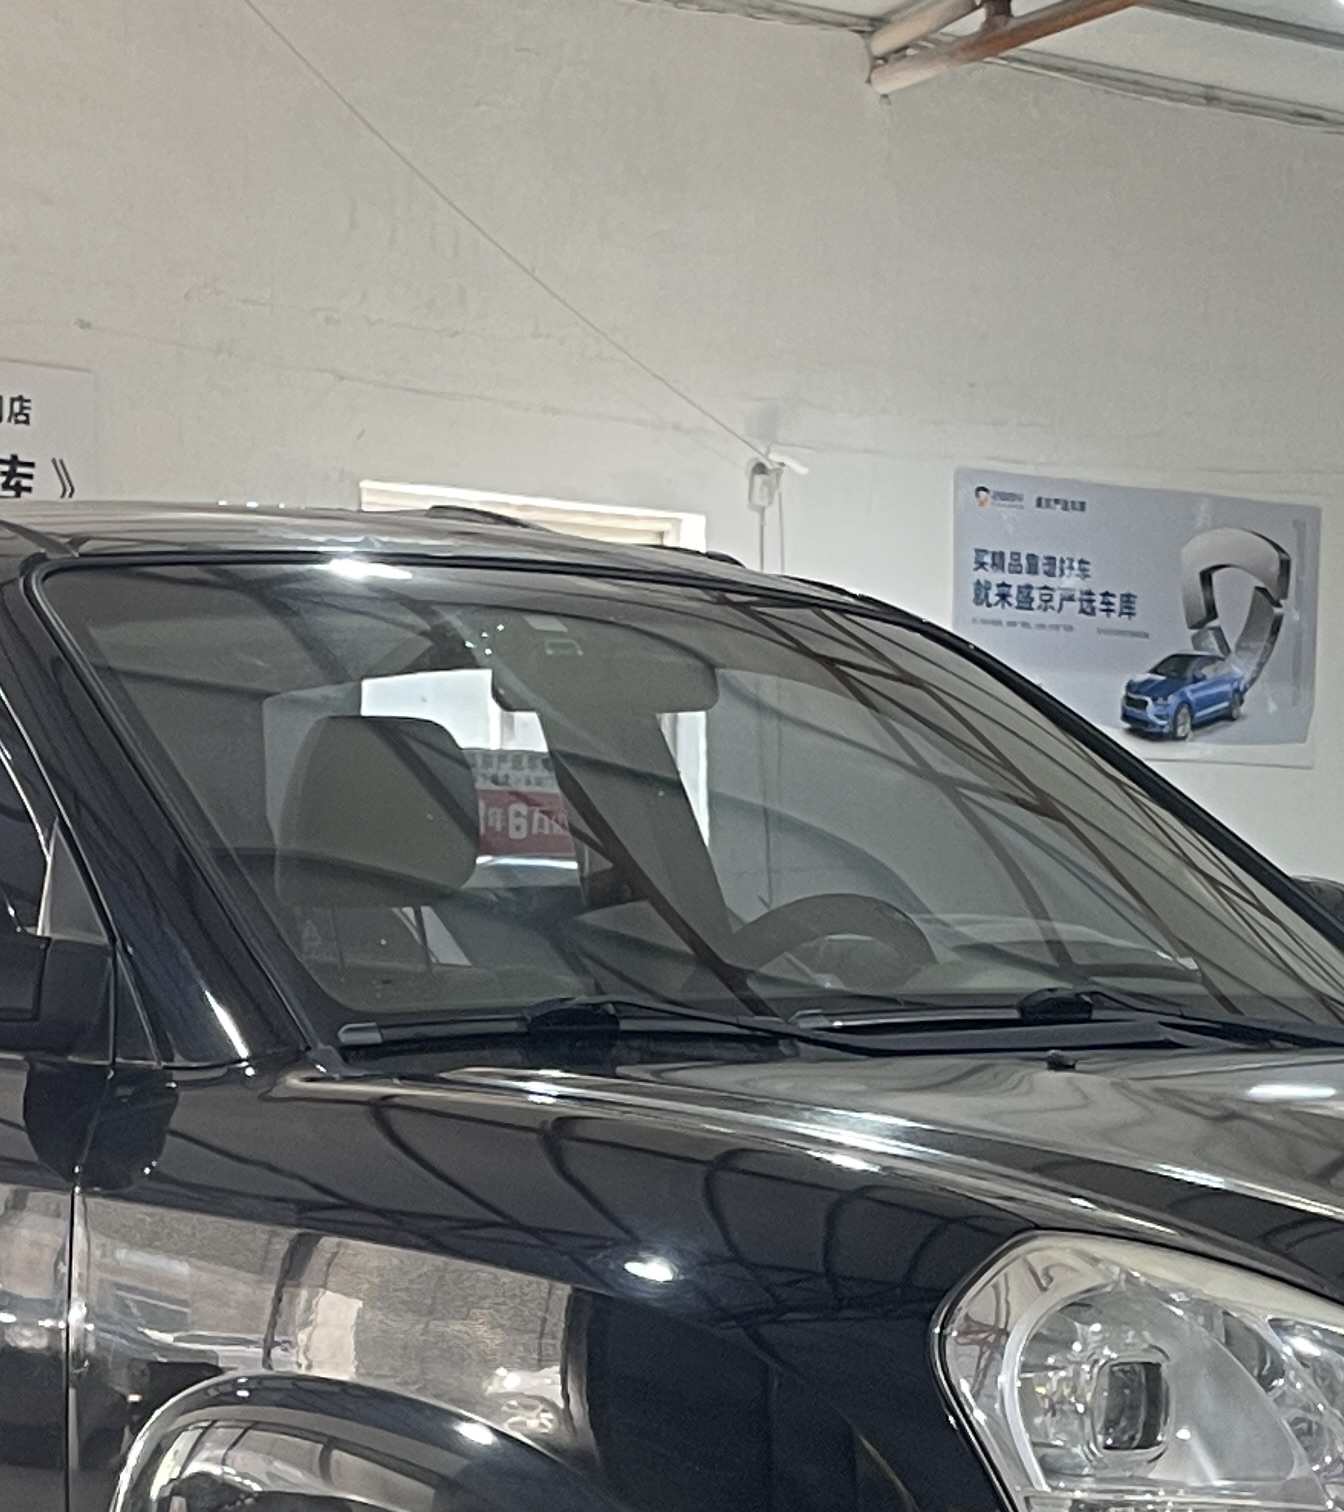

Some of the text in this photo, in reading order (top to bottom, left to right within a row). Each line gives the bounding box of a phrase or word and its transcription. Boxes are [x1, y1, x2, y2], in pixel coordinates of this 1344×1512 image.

[972, 578, 1138, 621] 就来盛京严选车库
